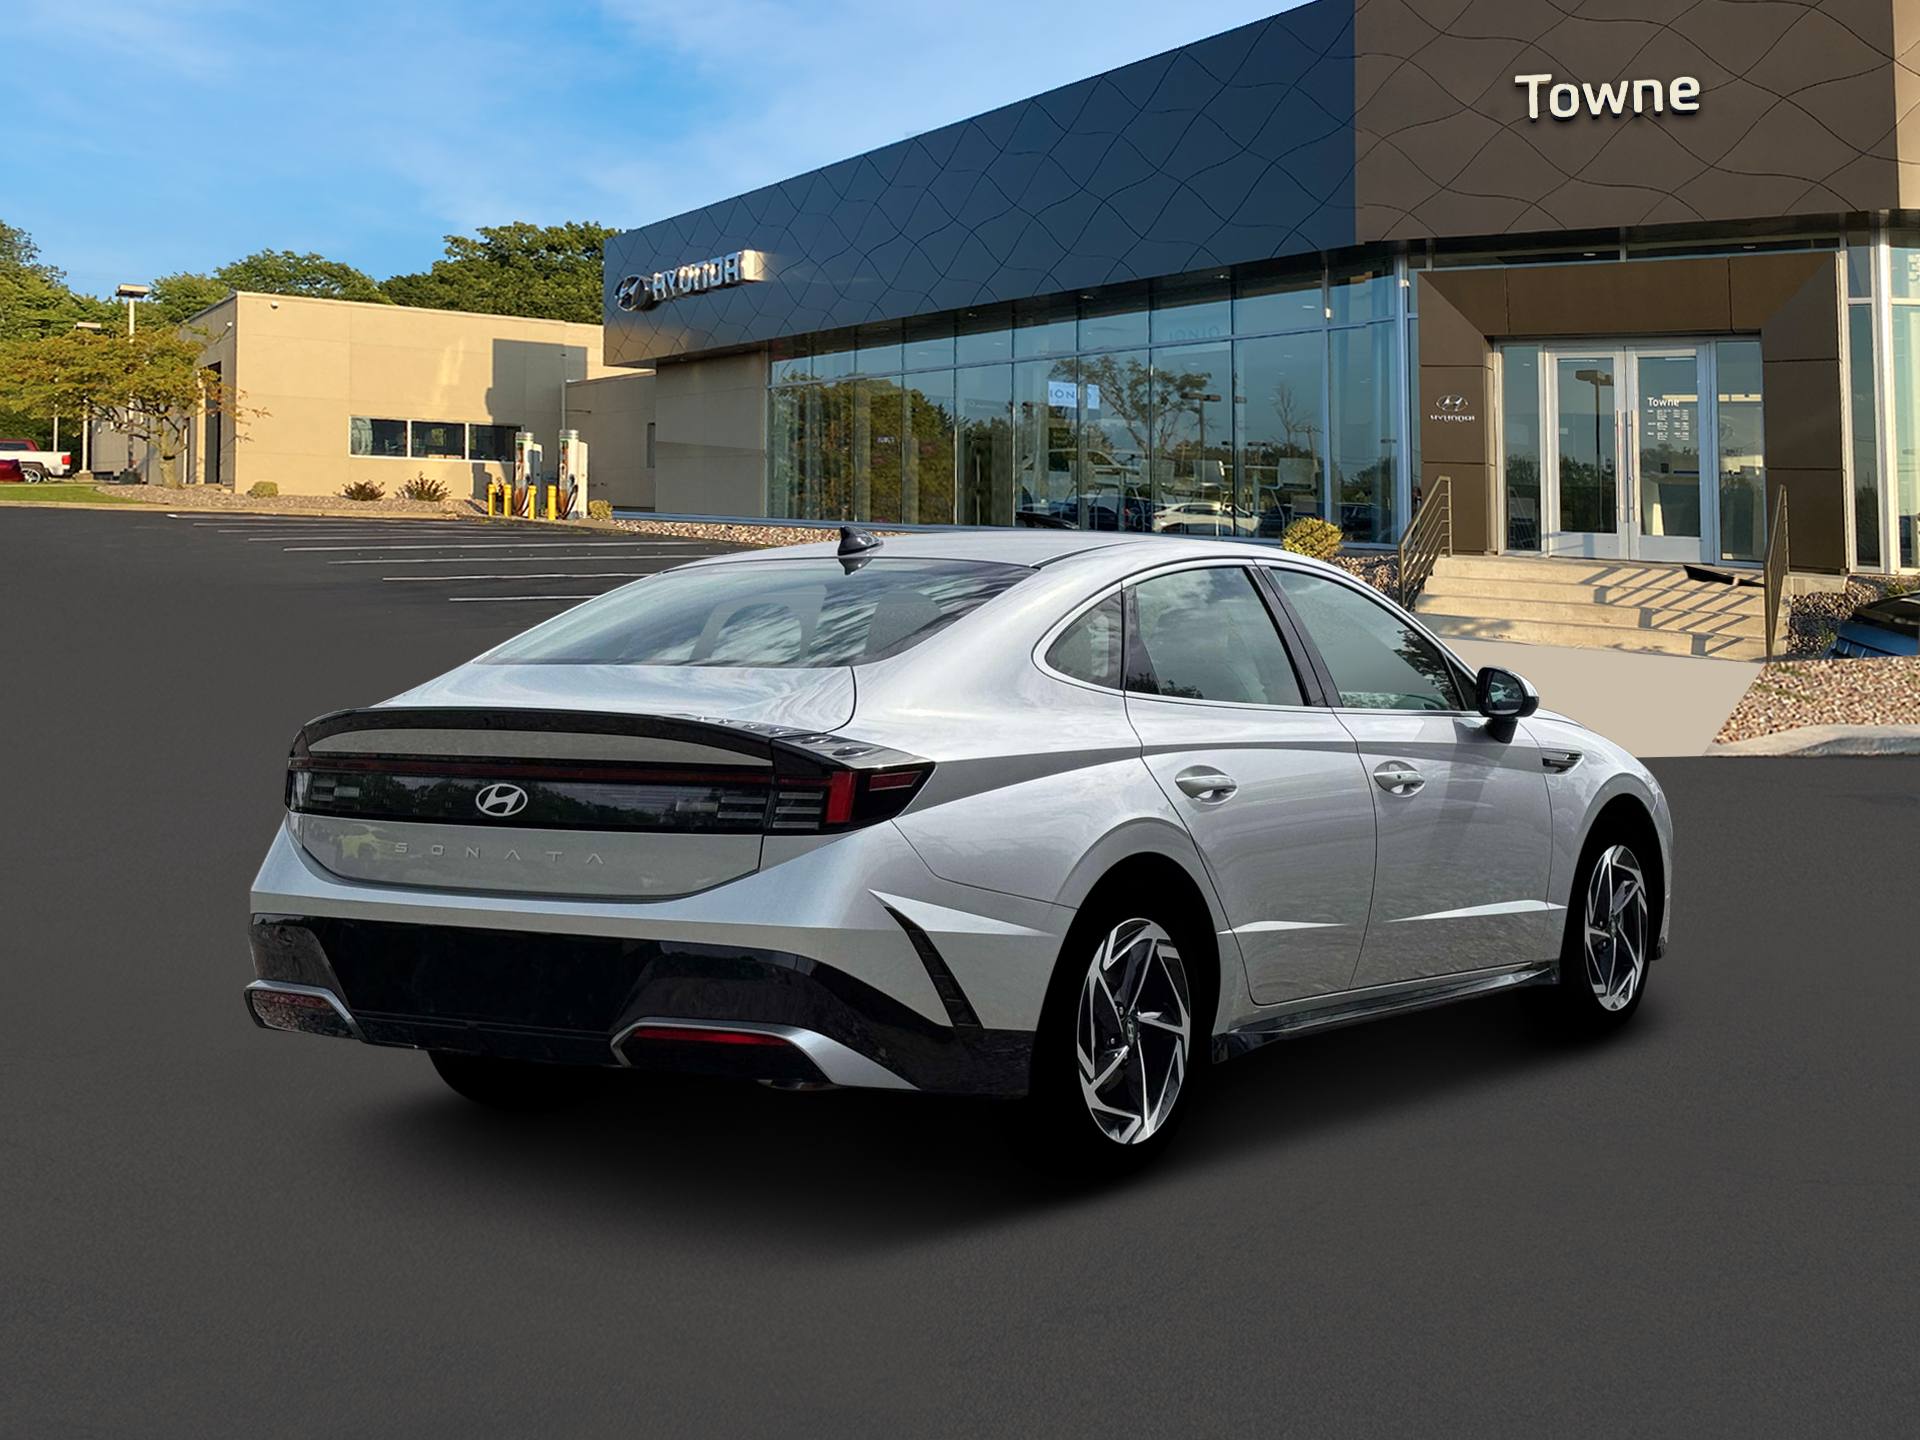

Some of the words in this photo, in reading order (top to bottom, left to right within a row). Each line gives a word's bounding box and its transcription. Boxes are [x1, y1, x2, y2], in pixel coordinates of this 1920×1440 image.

[1514, 73, 1701, 121] Towne
[1647, 397, 1679, 406] Towne
[395, 842, 604, 864] SONATA
